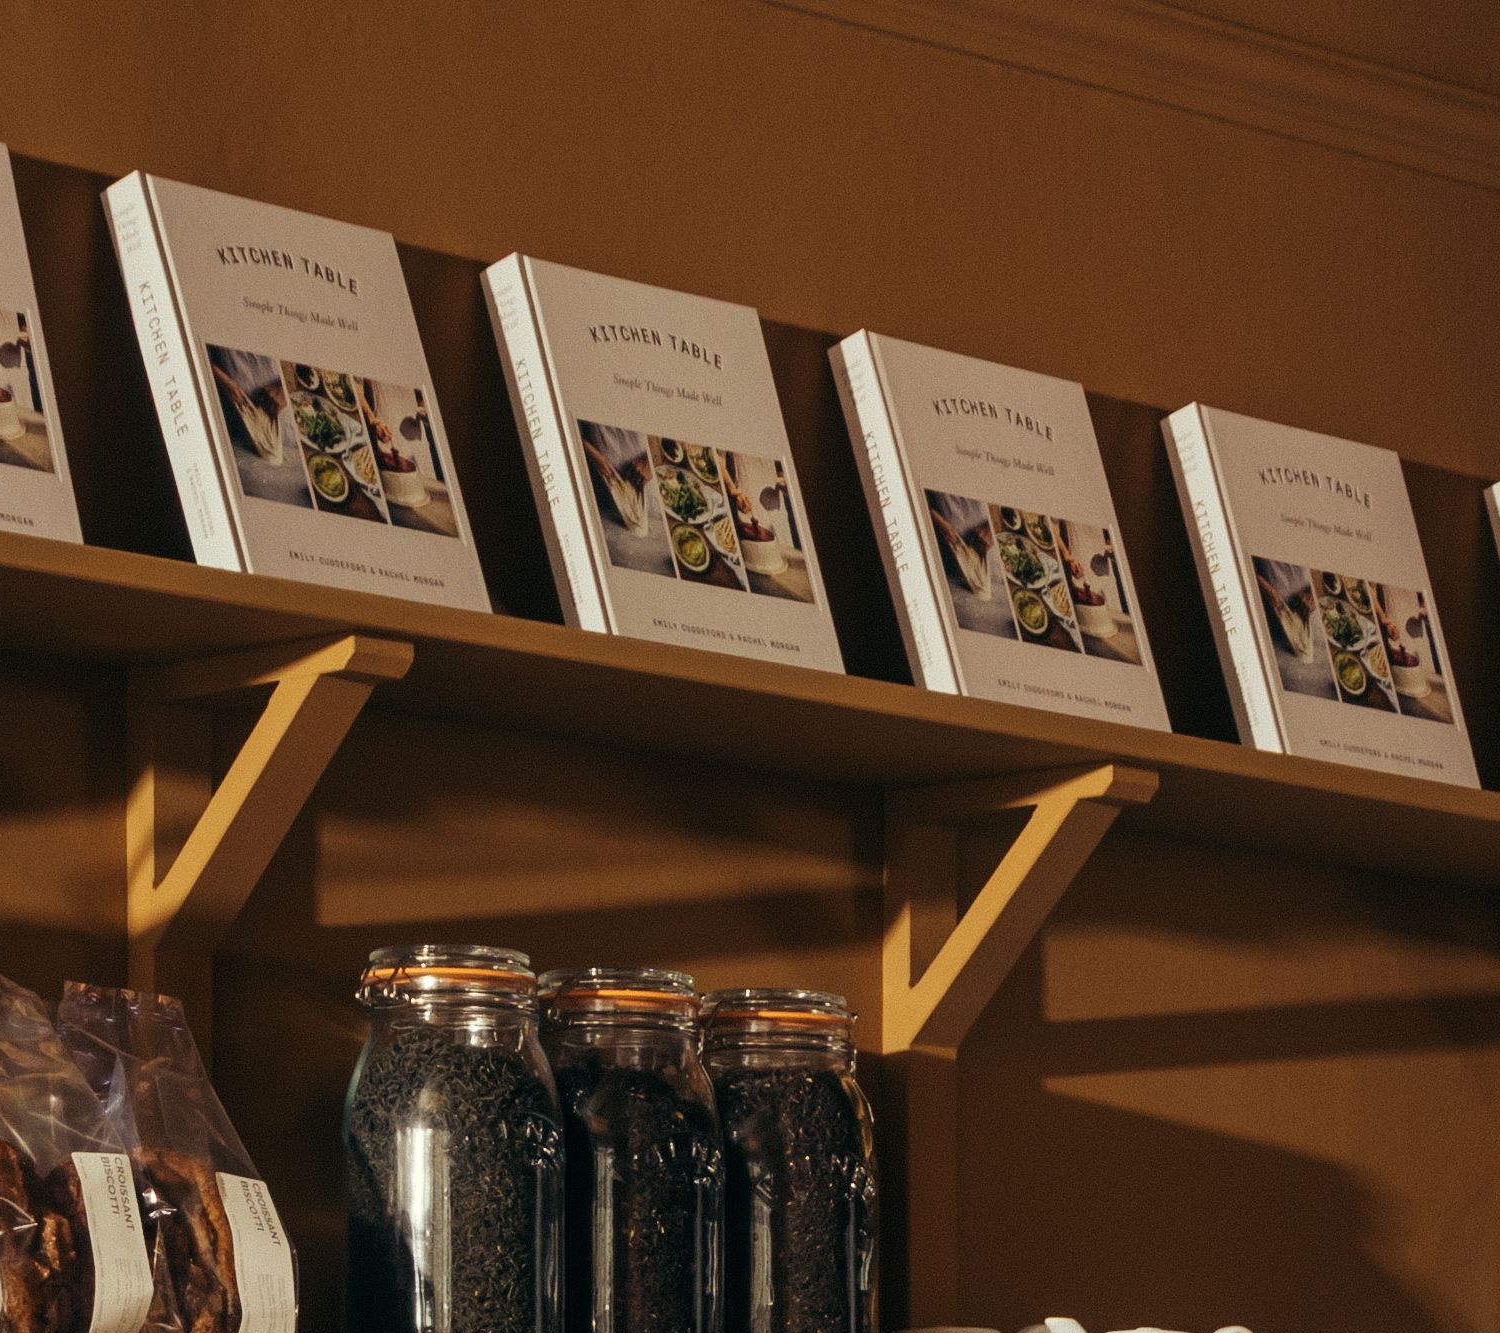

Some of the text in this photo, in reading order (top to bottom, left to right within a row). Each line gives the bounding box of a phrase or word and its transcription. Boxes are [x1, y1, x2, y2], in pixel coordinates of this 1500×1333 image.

[216, 245, 359, 296] KITCHEN TABLE
[138, 281, 189, 438] KITCHEN TABLE
[589, 324, 723, 370] KITCHEN TABLE
[516, 359, 561, 507] KITCHEN TABLE
[933, 399, 1054, 442] KITCHEN TABLE
[863, 431, 892, 510] KITCHEN
[1258, 467, 1372, 509] KITCHEN TABLE
[1195, 501, 1220, 576] KITCHEN
[100, 1155, 120, 1216] BISCOTTI
[114, 1156, 135, 1231] CROISSANT
[240, 1179, 264, 1232] BISCOTTI
[252, 1182, 281, 1247] CROISSANT
